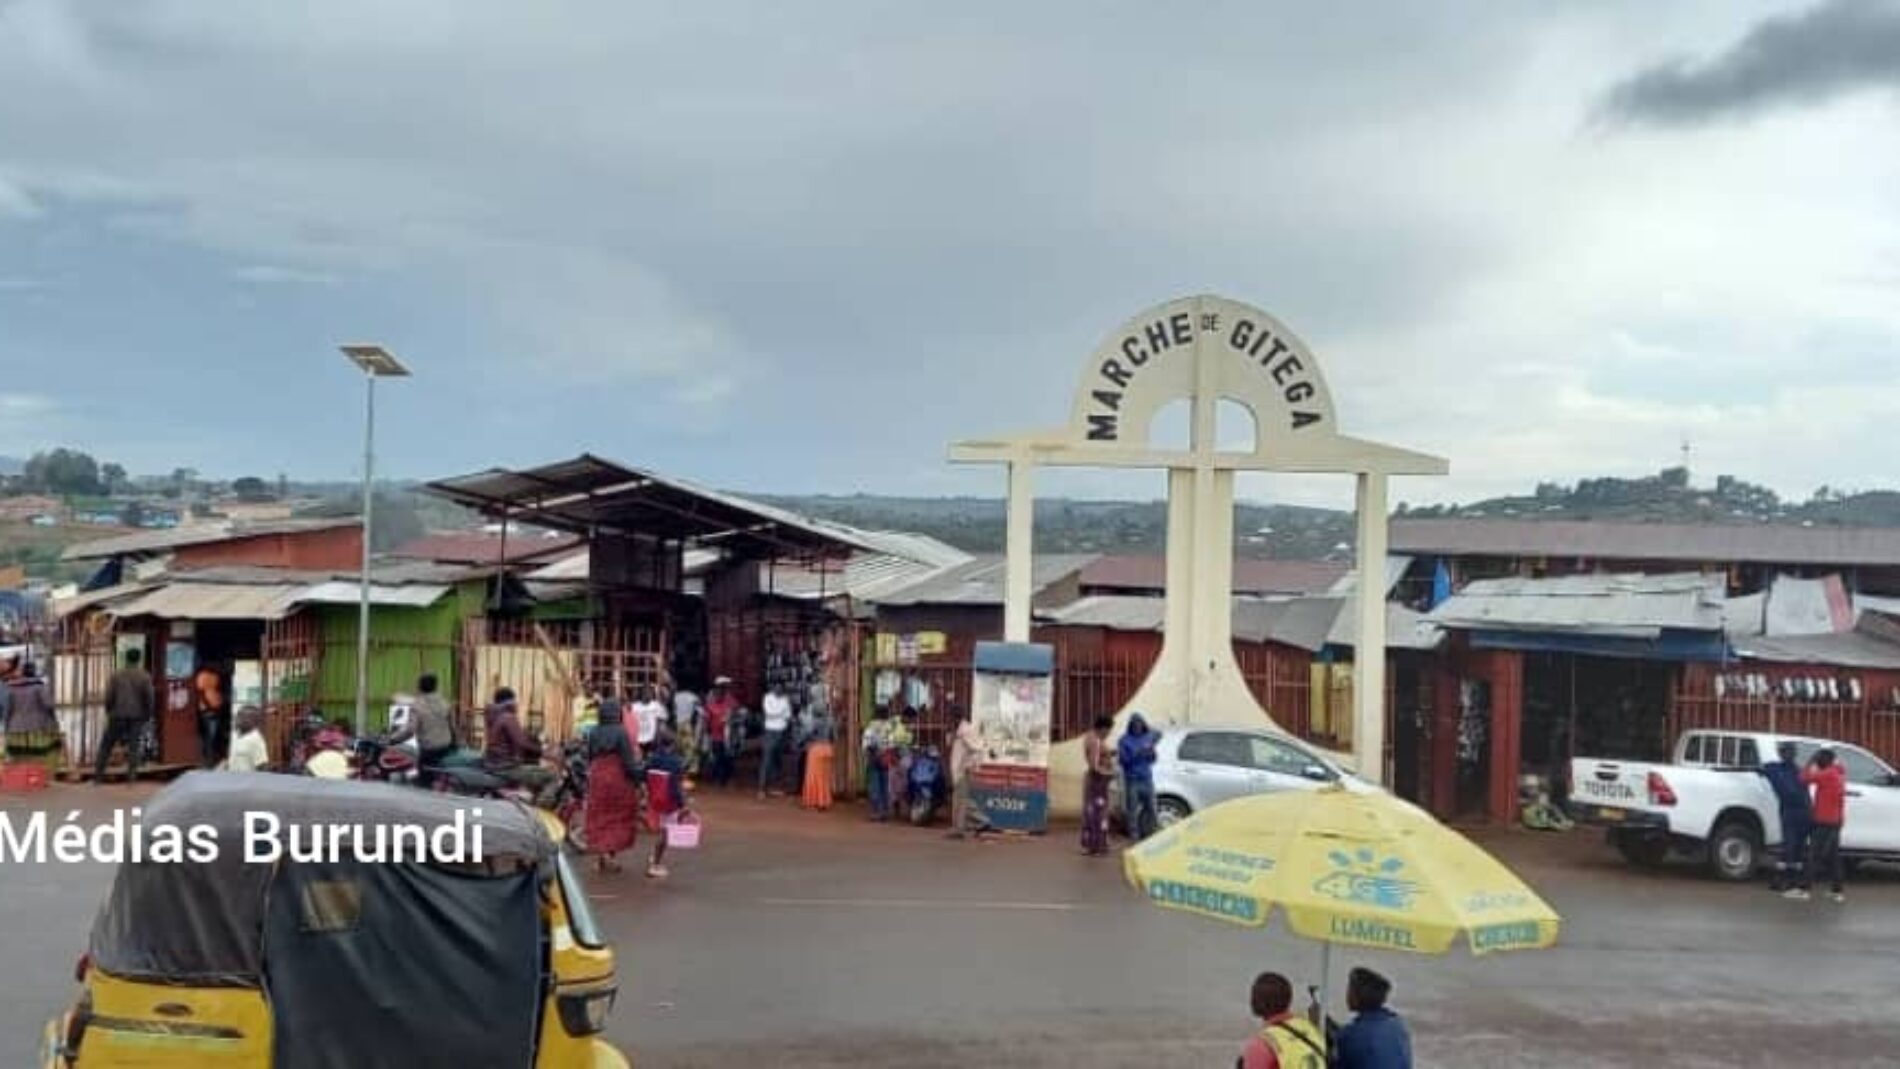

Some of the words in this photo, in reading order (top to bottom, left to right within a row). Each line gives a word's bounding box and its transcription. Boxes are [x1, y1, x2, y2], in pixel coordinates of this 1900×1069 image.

[1086, 312, 1193, 441] MARCHE
[1201, 314, 1220, 332] DE
[1229, 319, 1322, 430] GITEGA
[1584, 780, 1635, 799] TOYOTA
[1330, 914, 1418, 949] LUMITEL
